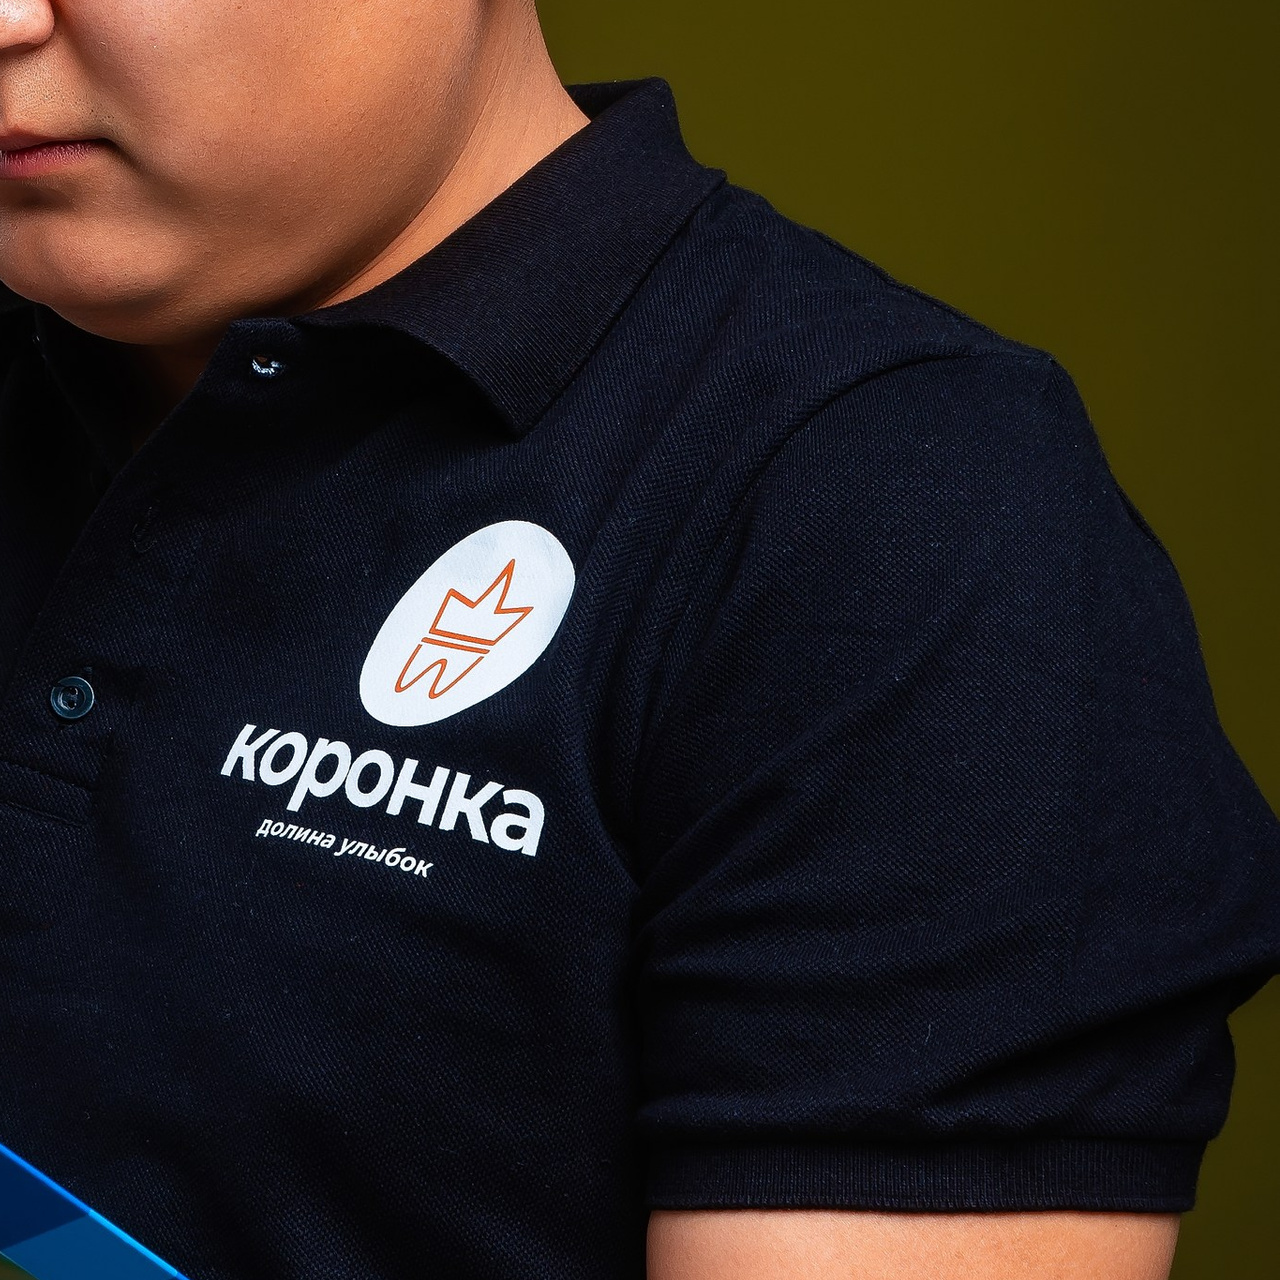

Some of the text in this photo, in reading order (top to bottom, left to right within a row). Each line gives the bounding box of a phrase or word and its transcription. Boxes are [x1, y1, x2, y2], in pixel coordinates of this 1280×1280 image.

[220, 723, 546, 857] коронка
[255, 818, 433, 878] долина улыбок
